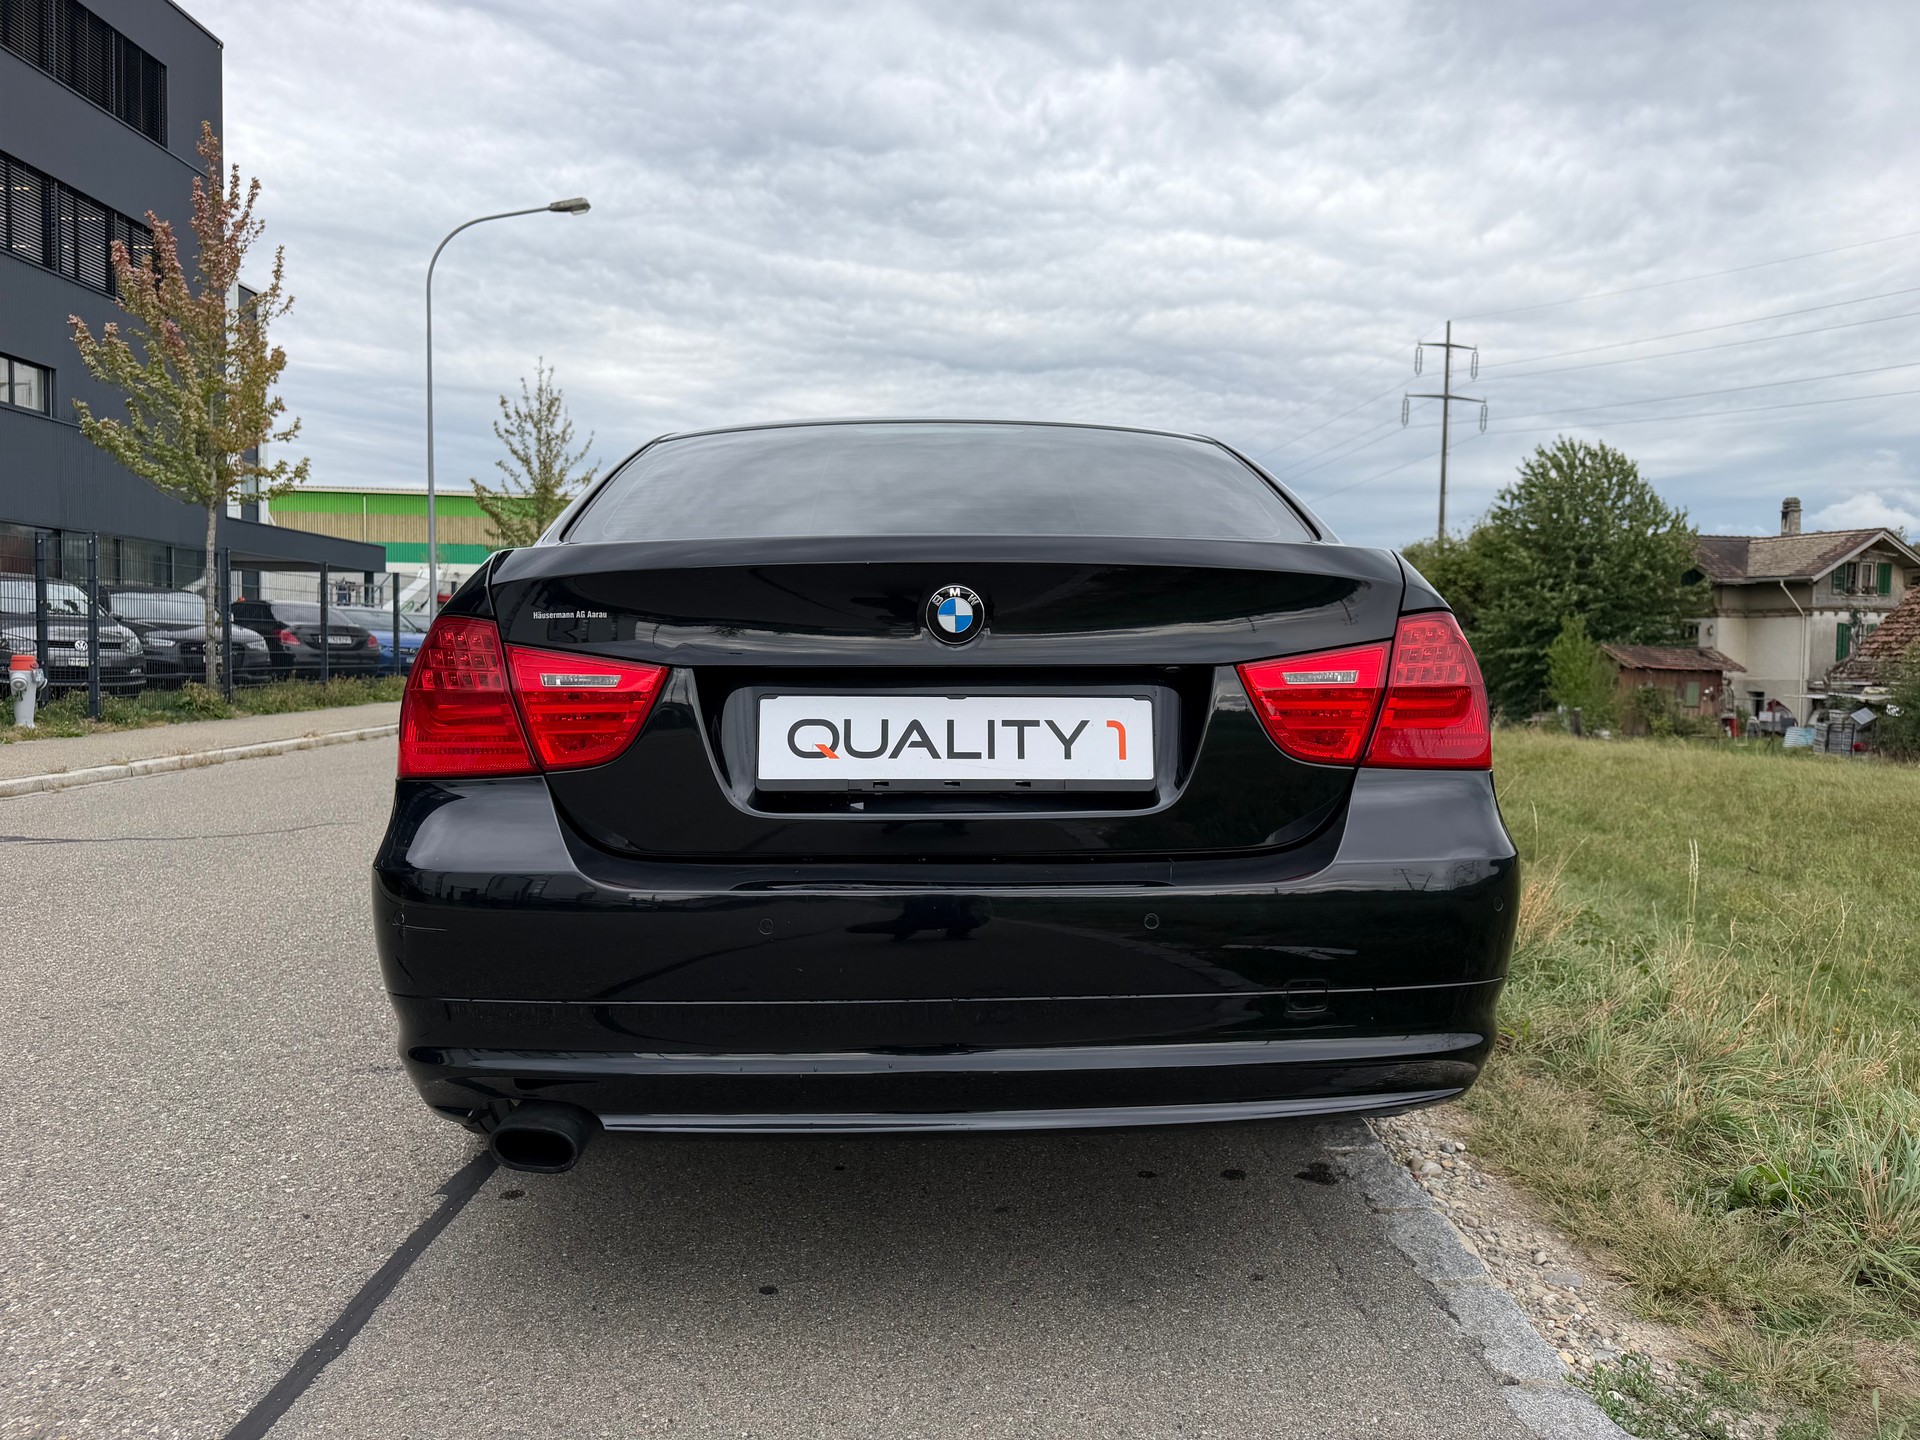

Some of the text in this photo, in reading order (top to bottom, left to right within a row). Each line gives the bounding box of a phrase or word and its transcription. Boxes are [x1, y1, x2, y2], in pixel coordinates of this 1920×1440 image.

[931, 587, 980, 607] BMW
[533, 611, 608, 620] Häusermann AG Aarau
[786, 718, 1127, 761] QUALITY 1
